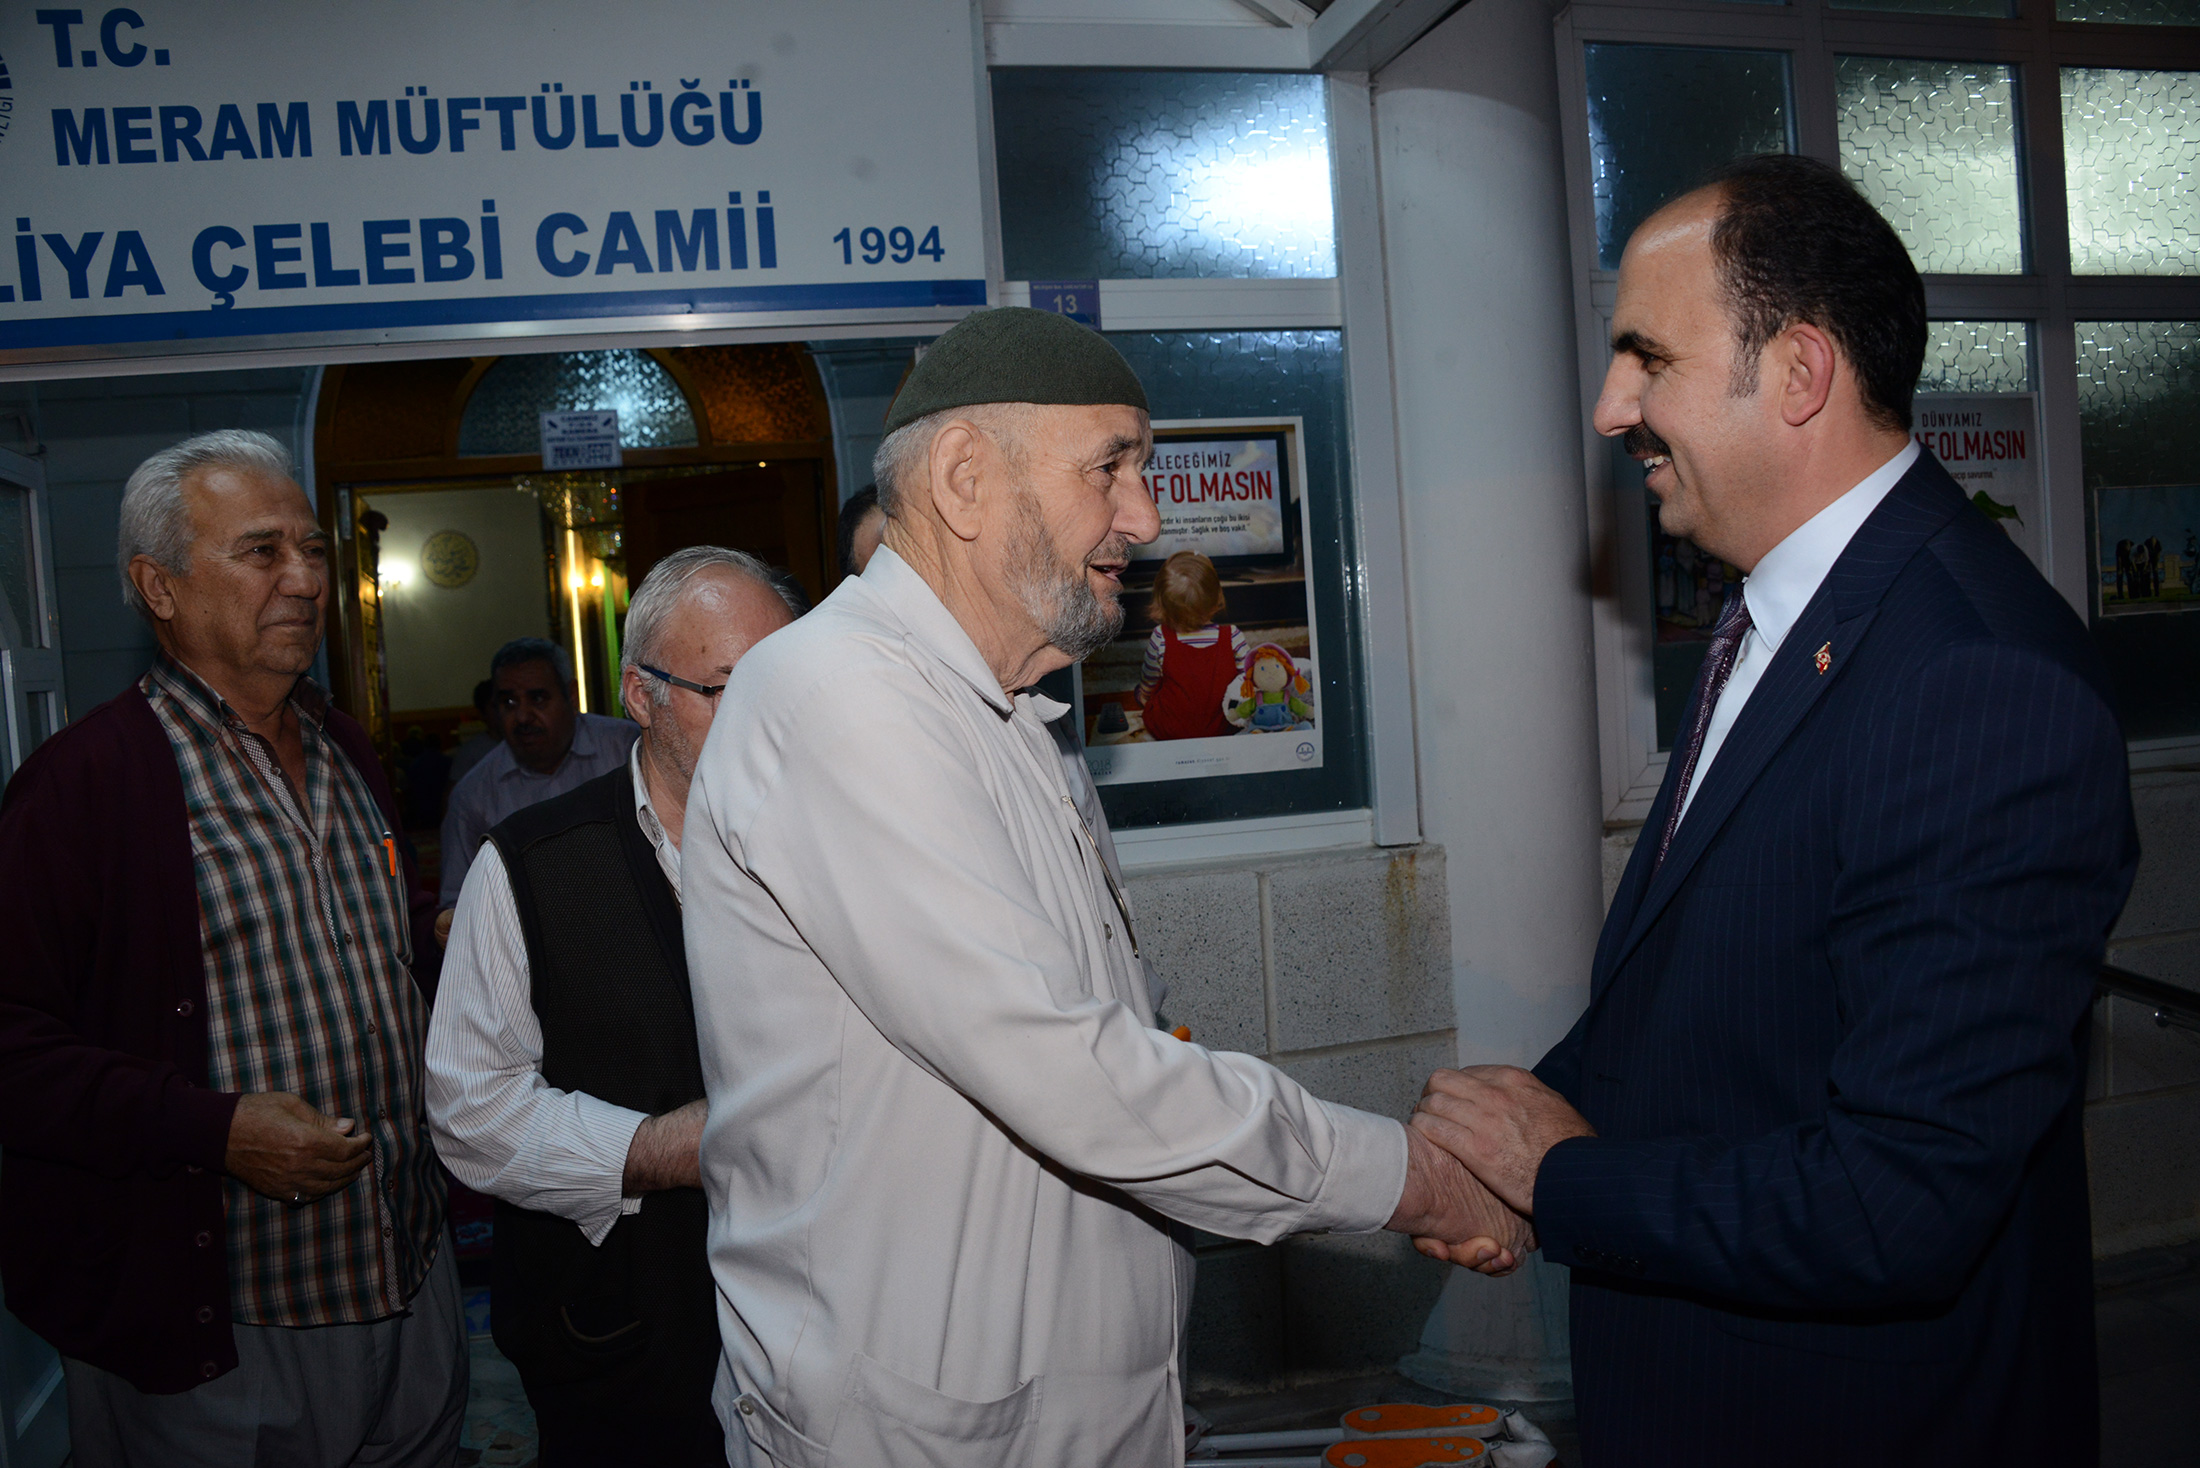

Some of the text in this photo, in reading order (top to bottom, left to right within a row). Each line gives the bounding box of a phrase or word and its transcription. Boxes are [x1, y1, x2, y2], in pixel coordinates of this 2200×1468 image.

[36, 8, 171, 68] T.C.
[52, 78, 763, 166] MERAM MÜFTÜLÜĞÜ
[191, 199, 503, 310] ÇELEBİ
[535, 190, 777, 278] CAMİİ
[833, 225, 945, 265] 1994
[1053, 294, 1078, 314] 13
[1922, 411, 1982, 427] DÜNYAMIZ
[1144, 451, 1231, 470] ELECEĞİMİZ
[1939, 430, 2025, 460] OLMASIN
[1169, 470, 1273, 503] OLMASIN
